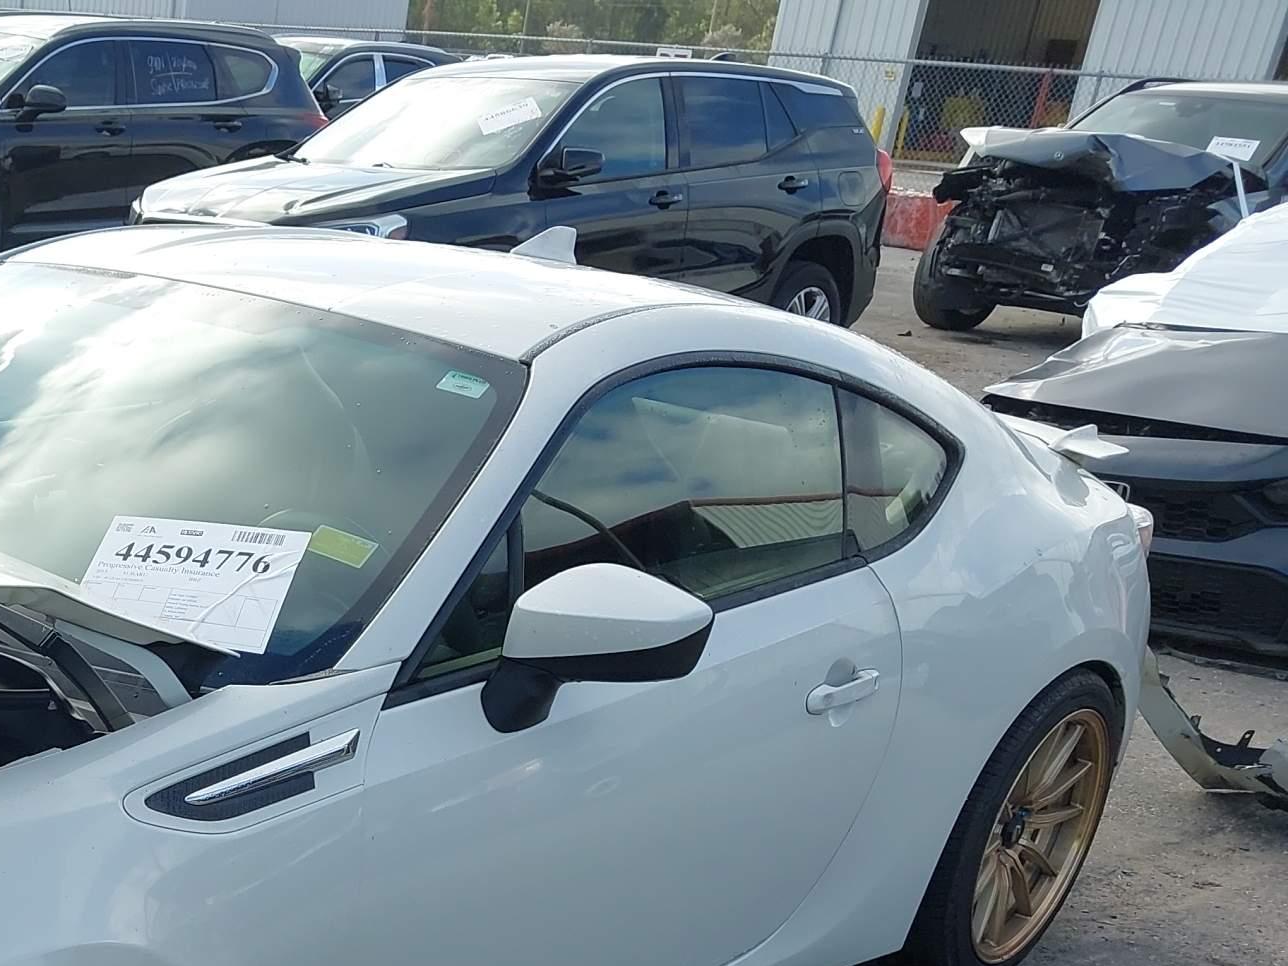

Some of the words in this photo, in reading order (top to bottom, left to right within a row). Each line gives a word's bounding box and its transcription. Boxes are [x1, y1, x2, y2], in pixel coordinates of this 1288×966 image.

[98, 560, 143, 571] Progressive
[145, 564, 178, 575] Casualty
[181, 567, 221, 578] Insurance
[115, 542, 270, 574] 44594776
